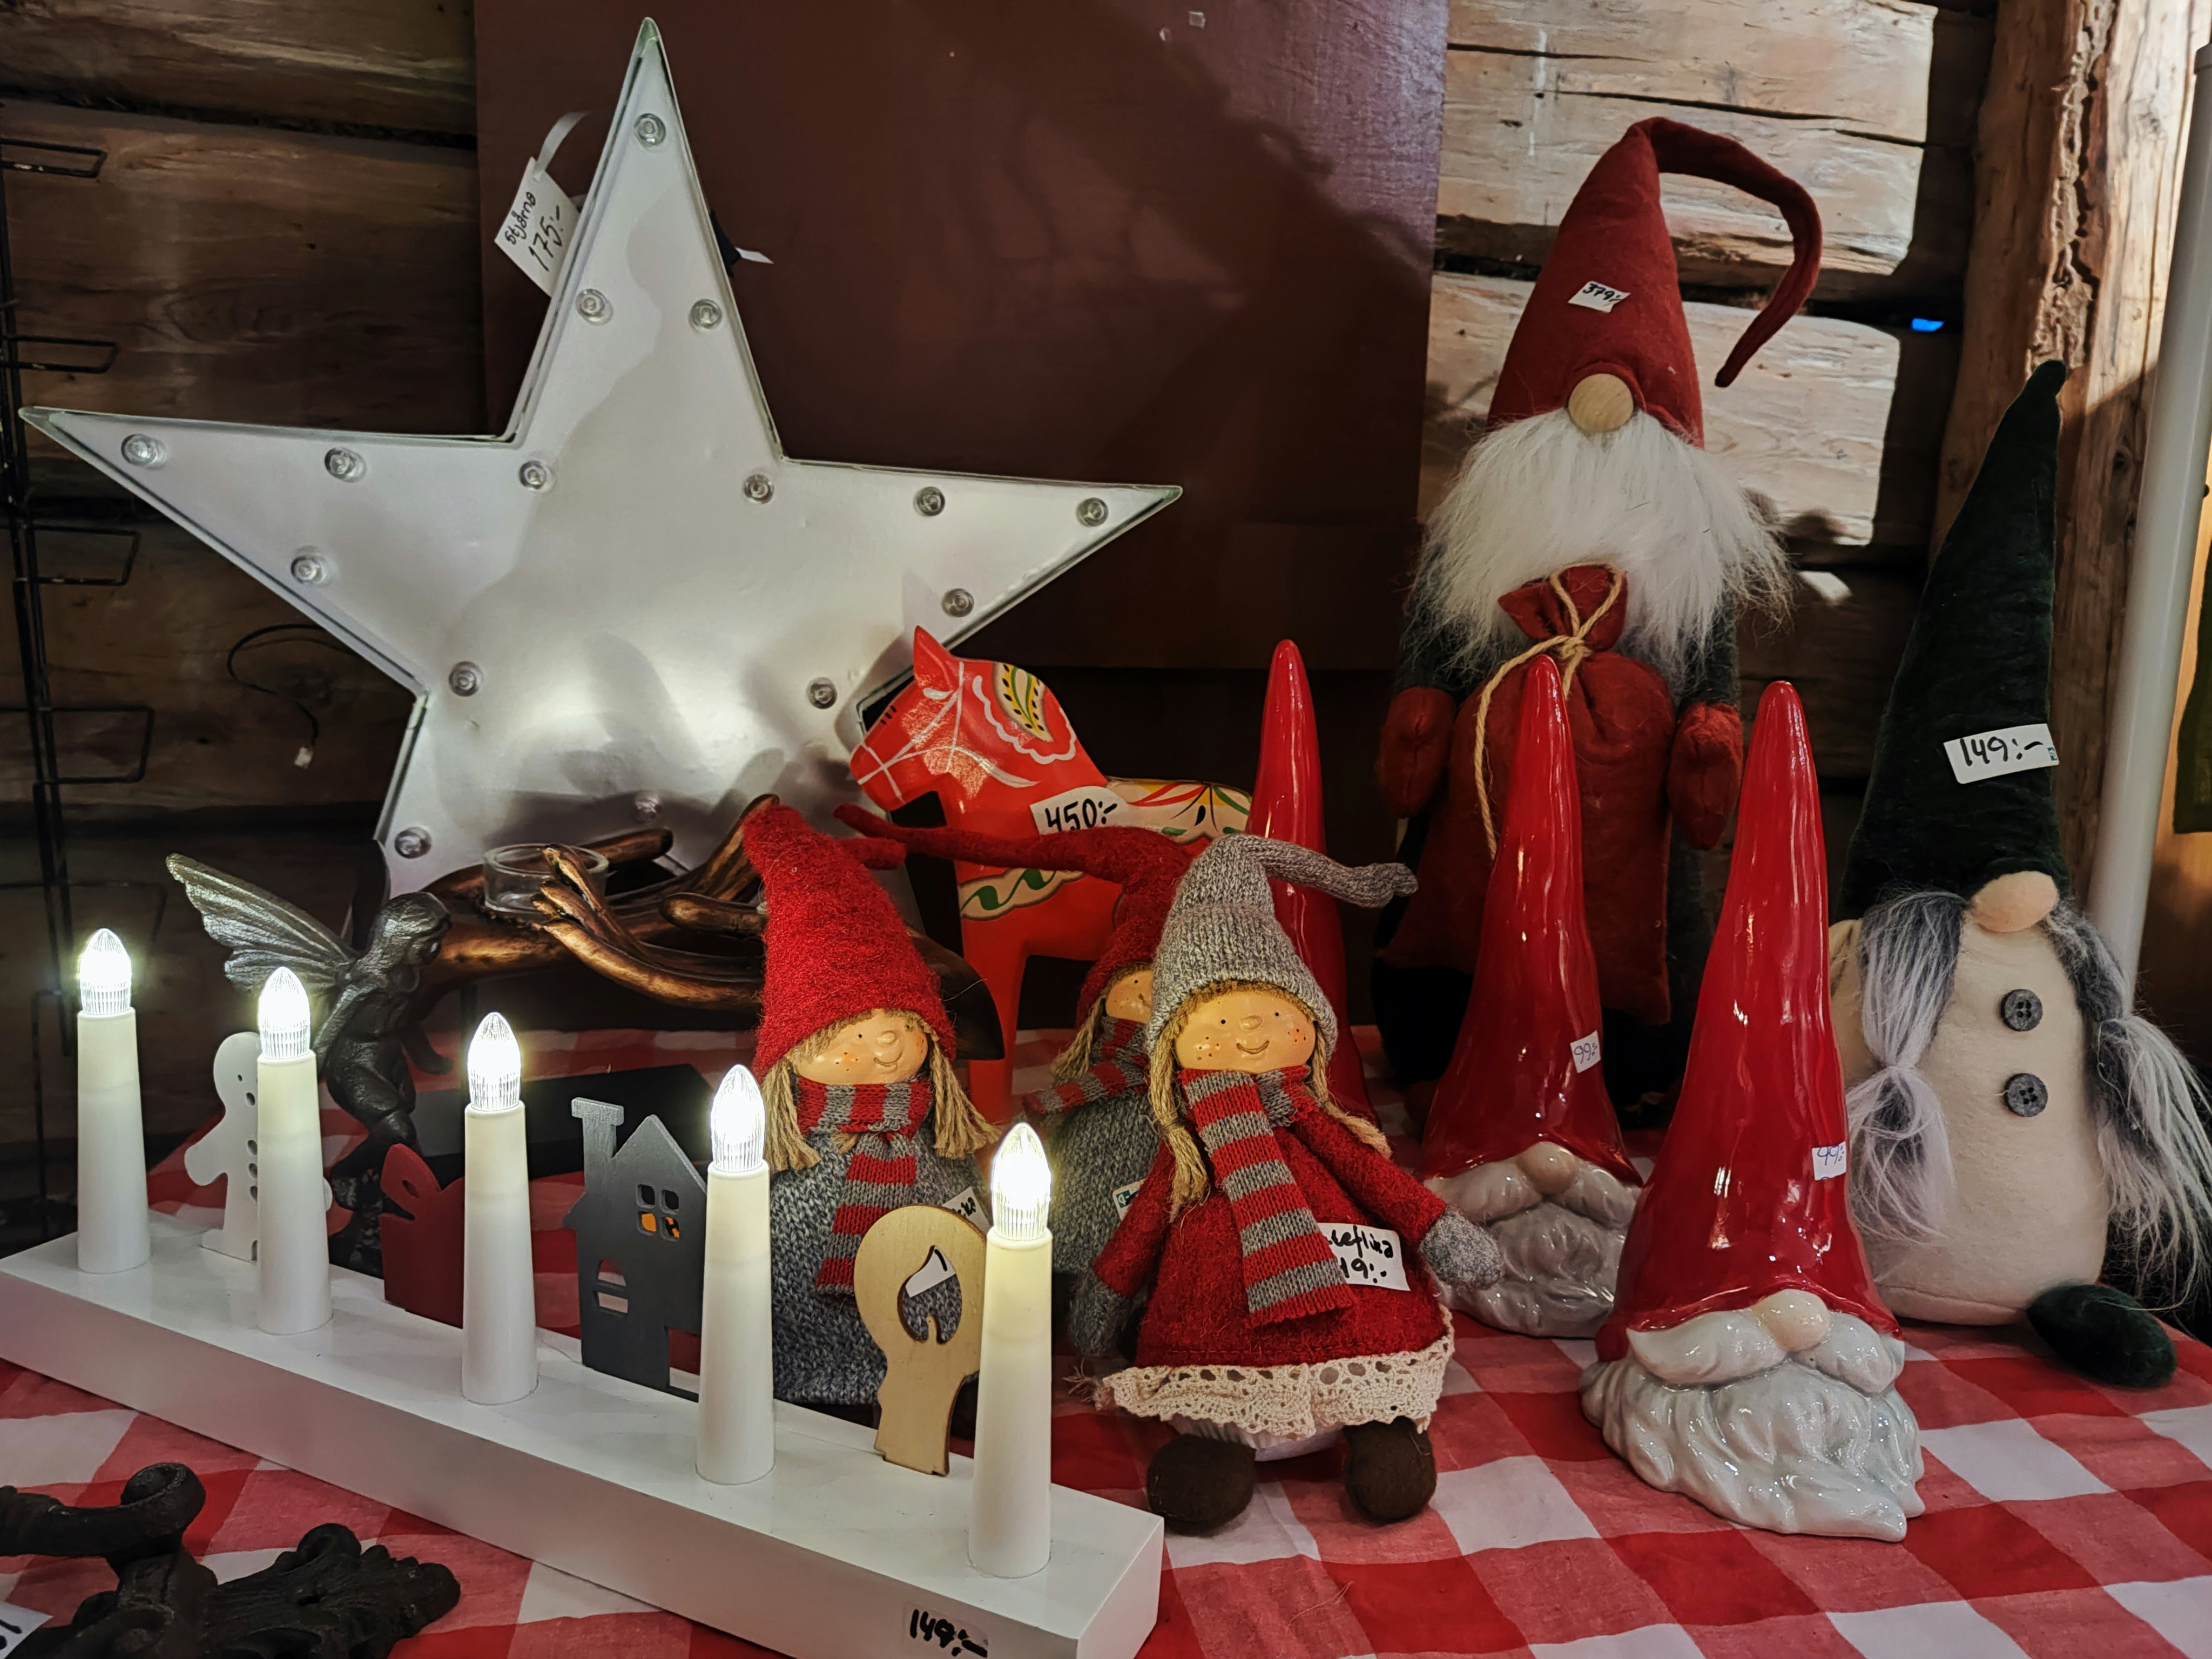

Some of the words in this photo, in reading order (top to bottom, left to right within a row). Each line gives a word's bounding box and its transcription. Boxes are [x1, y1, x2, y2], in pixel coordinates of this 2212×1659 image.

[1960, 736, 2044, 766] 149:-
[1044, 798, 1118, 832] 450:-
[909, 1609, 988, 1658] 149:-
